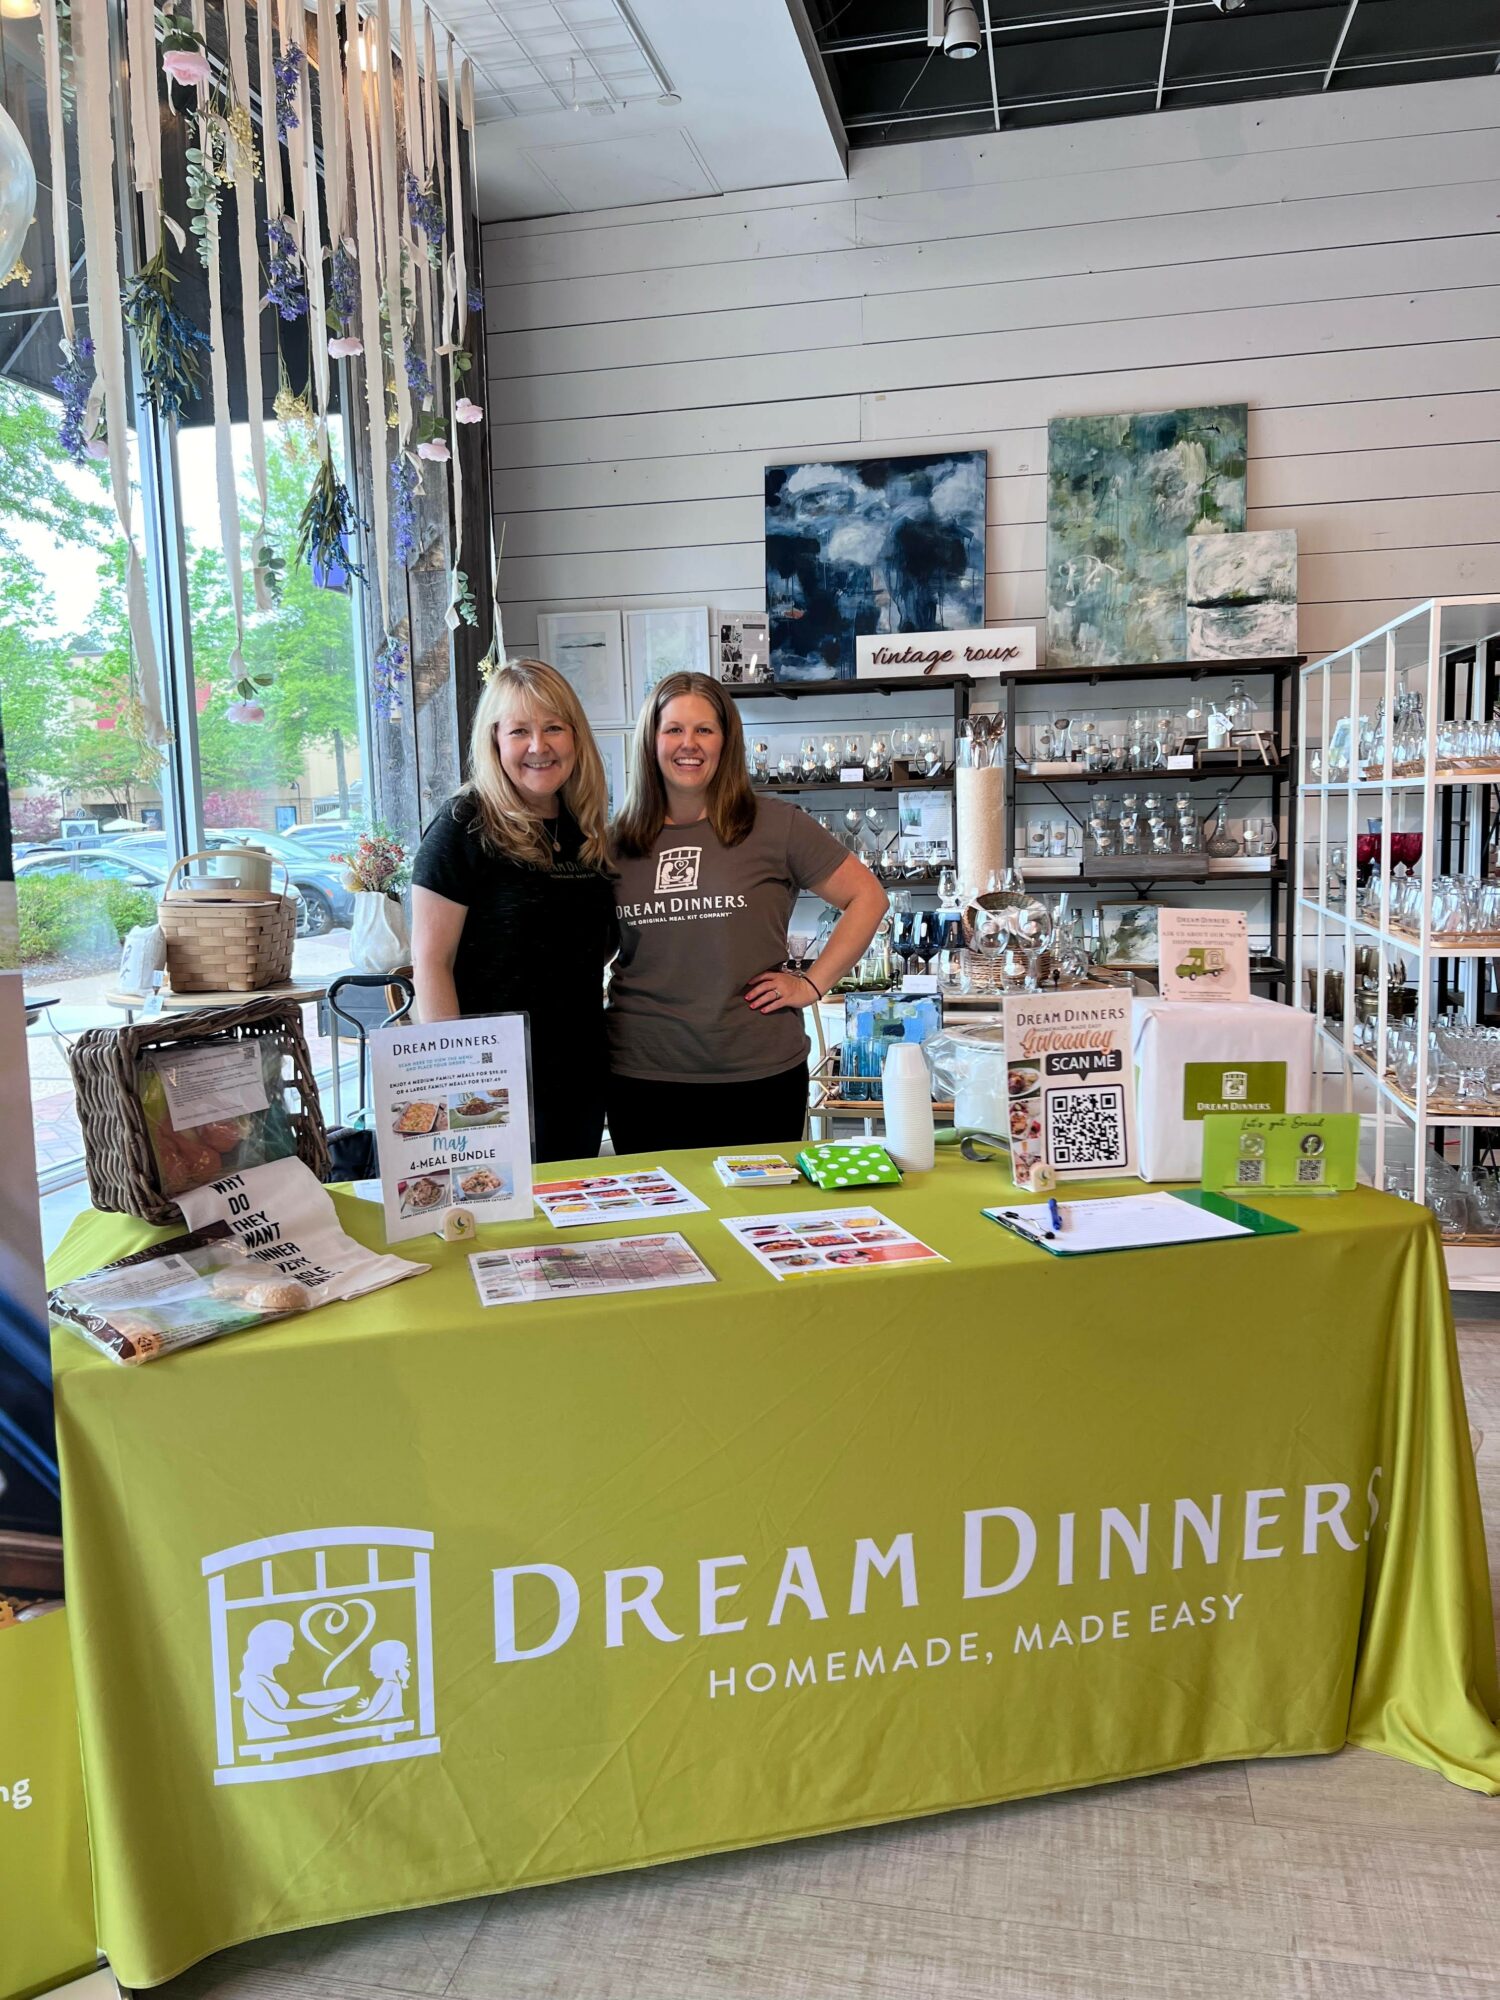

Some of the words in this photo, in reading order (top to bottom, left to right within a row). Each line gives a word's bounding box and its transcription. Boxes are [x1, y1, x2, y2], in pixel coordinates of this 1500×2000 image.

[963, 645, 1020, 662] roux
[615, 901, 666, 920] DREAM
[638, 917, 668, 925] ORIGINAL
[1016, 1012, 1061, 1026] DREAM
[1064, 1008, 1125, 1022] DINNERS
[393, 1041, 437, 1056] DREAM
[1019, 1027, 1117, 1058] Giveaway
[1051, 1055, 1090, 1071] SCAN
[1094, 1054, 1116, 1068] ME
[389, 1081, 407, 1089] ENJOY
[1197, 1102, 1229, 1111] DREAM
[433, 1135, 469, 1153] May
[410, 1157, 447, 1171] 4-MEAL
[451, 1149, 496, 1163] BUNDLE
[209, 1174, 246, 1195] WHY
[228, 1193, 250, 1215] DO
[231, 1211, 270, 1232] THEY
[242, 1222, 281, 1249] WANT
[275, 1257, 312, 1274] VERY
[292, 1266, 331, 1281] NGLE
[491, 1532, 920, 1665] DREAM
[960, 1466, 1383, 1600] DINNERS
[707, 1632, 996, 1700] HOMEMADE,
[1012, 1609, 1132, 1655] MADE
[1146, 1591, 1247, 1636] EASY
